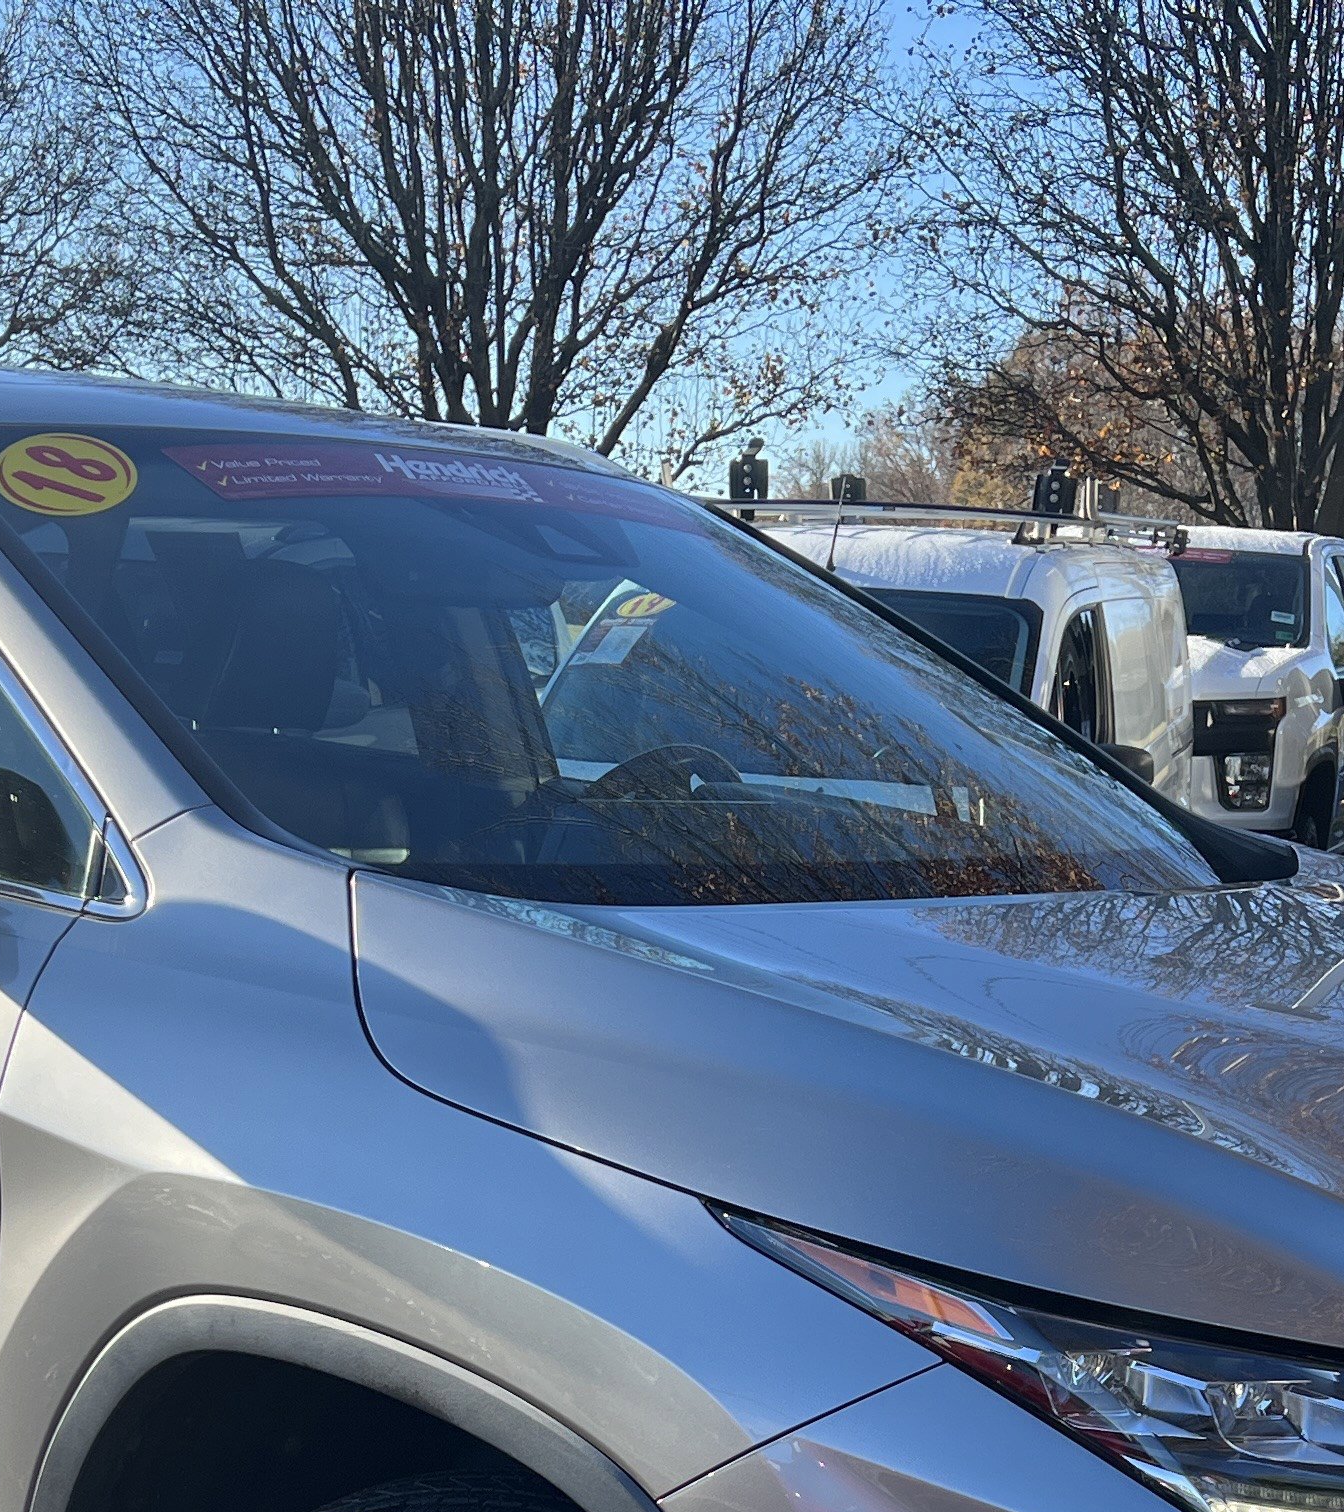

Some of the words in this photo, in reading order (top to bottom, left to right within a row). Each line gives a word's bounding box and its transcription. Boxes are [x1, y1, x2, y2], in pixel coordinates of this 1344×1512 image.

[11, 445, 117, 503] 18
[211, 458, 261, 470] Value
[264, 457, 321, 468] Priced
[374, 453, 526, 485] Hendrick
[231, 473, 297, 485] Limited
[300, 472, 383, 484] Warranty
